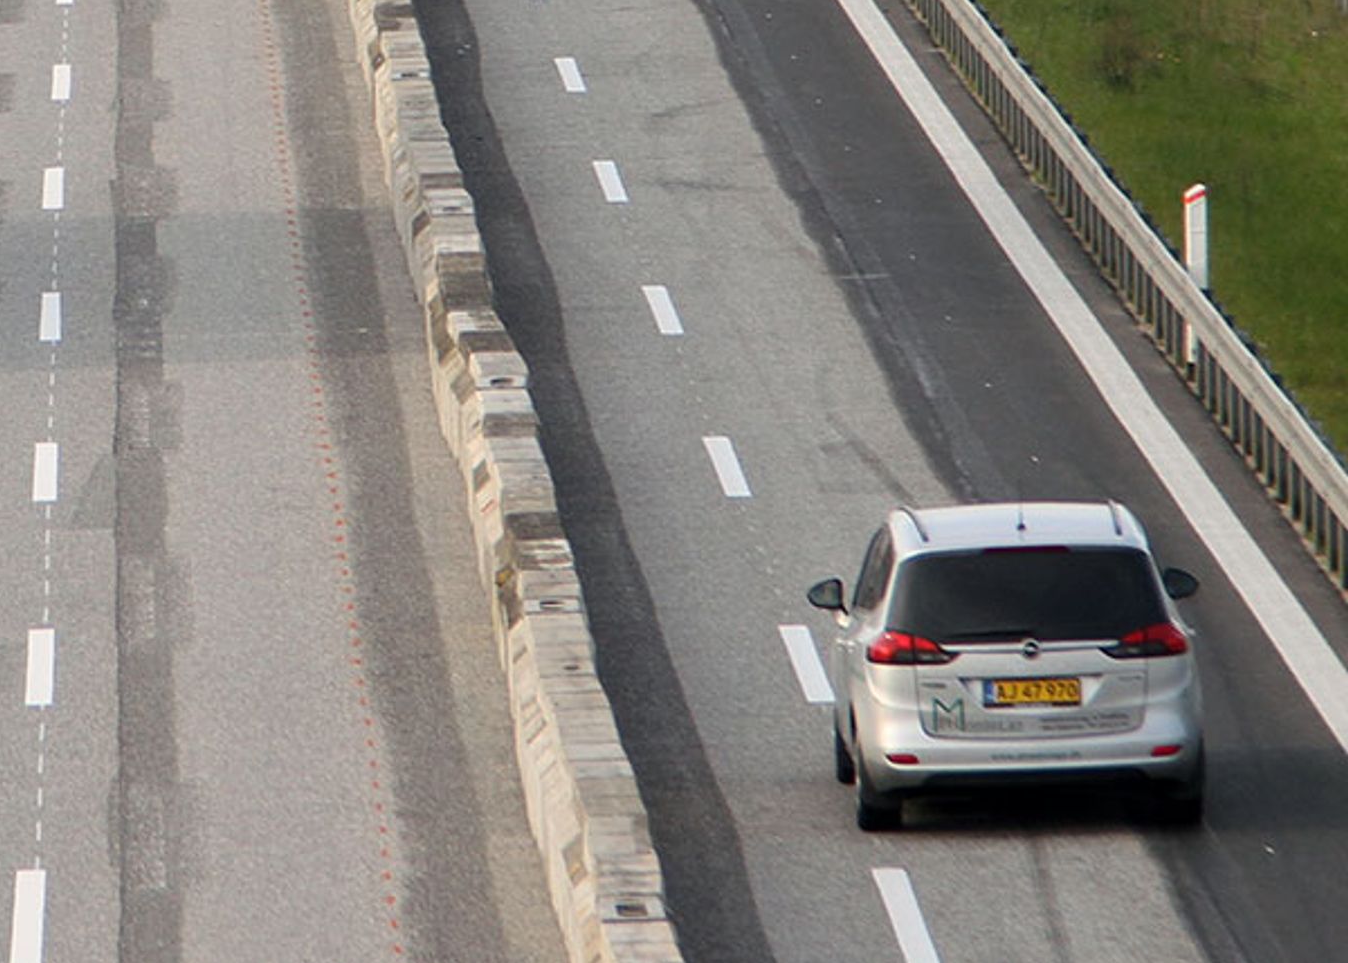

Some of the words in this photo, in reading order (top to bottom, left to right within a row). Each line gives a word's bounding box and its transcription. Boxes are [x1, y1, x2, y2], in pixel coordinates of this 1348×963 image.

[997, 684, 1017, 699] AJ
[1022, 682, 1042, 698] 47
[1046, 681, 1079, 698] 970
